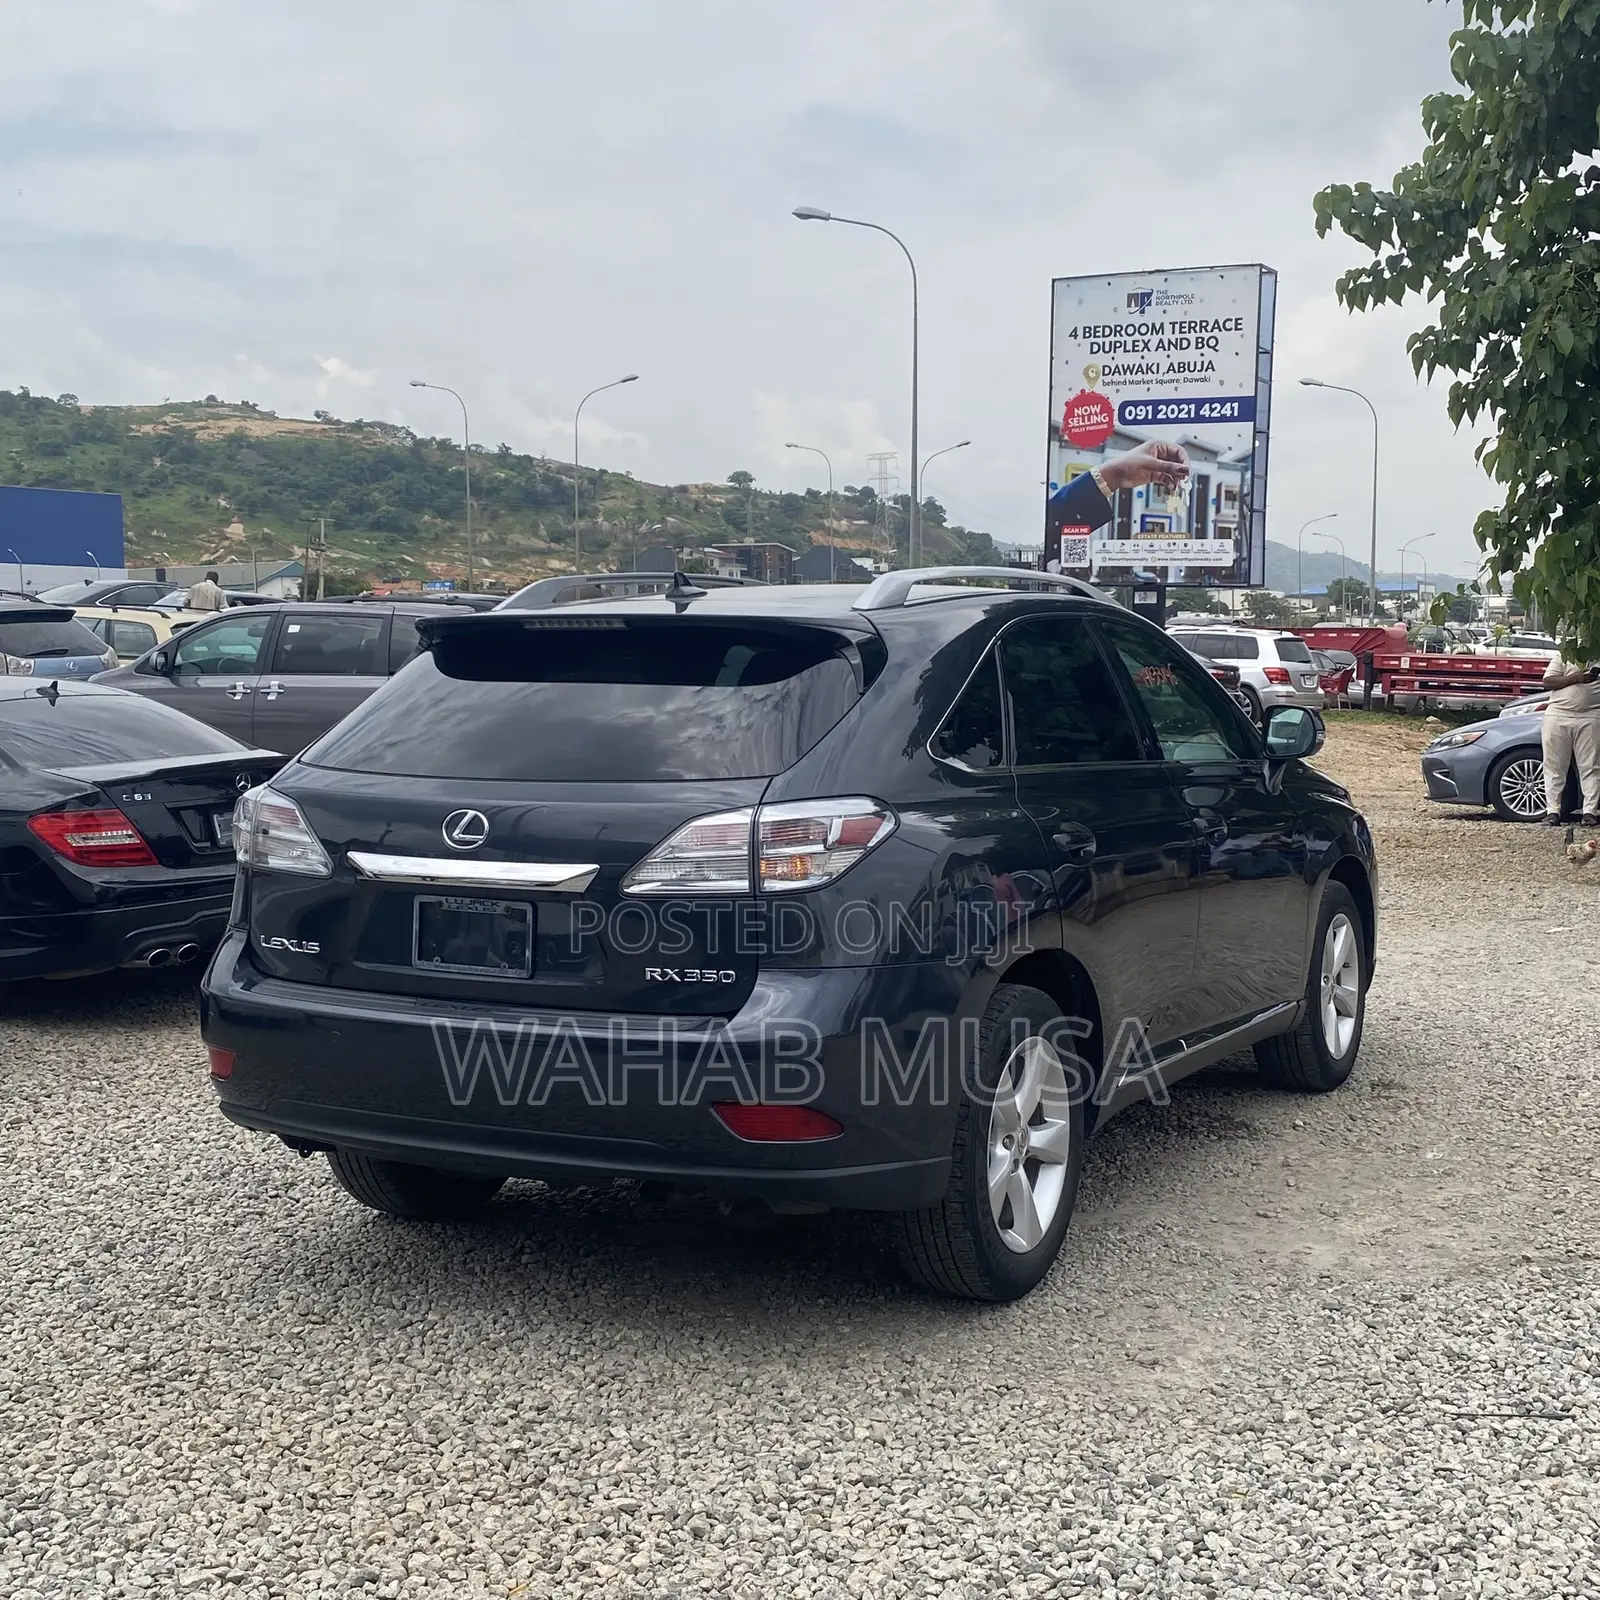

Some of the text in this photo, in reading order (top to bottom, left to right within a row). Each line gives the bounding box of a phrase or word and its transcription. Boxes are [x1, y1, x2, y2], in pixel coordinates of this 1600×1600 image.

[1155, 293, 1195, 301] NORTHPOLE
[1068, 317, 1244, 339] 4 BEDROOM TERRACE
[1089, 335, 1220, 355] DUPLEX AND BQ
[1101, 362, 1160, 377] DAWAKI
[1102, 376, 1128, 387] behind
[1128, 377, 1154, 386] Market
[1183, 375, 1211, 384] Dawaki
[1074, 403, 1101, 417] NOW
[1124, 402, 1240, 420] 091 2021 4241
[1068, 413, 1109, 427] SELLING
[134, 793, 152, 801] 63
[445, 897, 500, 907] LUJACK
[260, 934, 321, 954] LEXUS
[645, 967, 736, 983] RX 350
